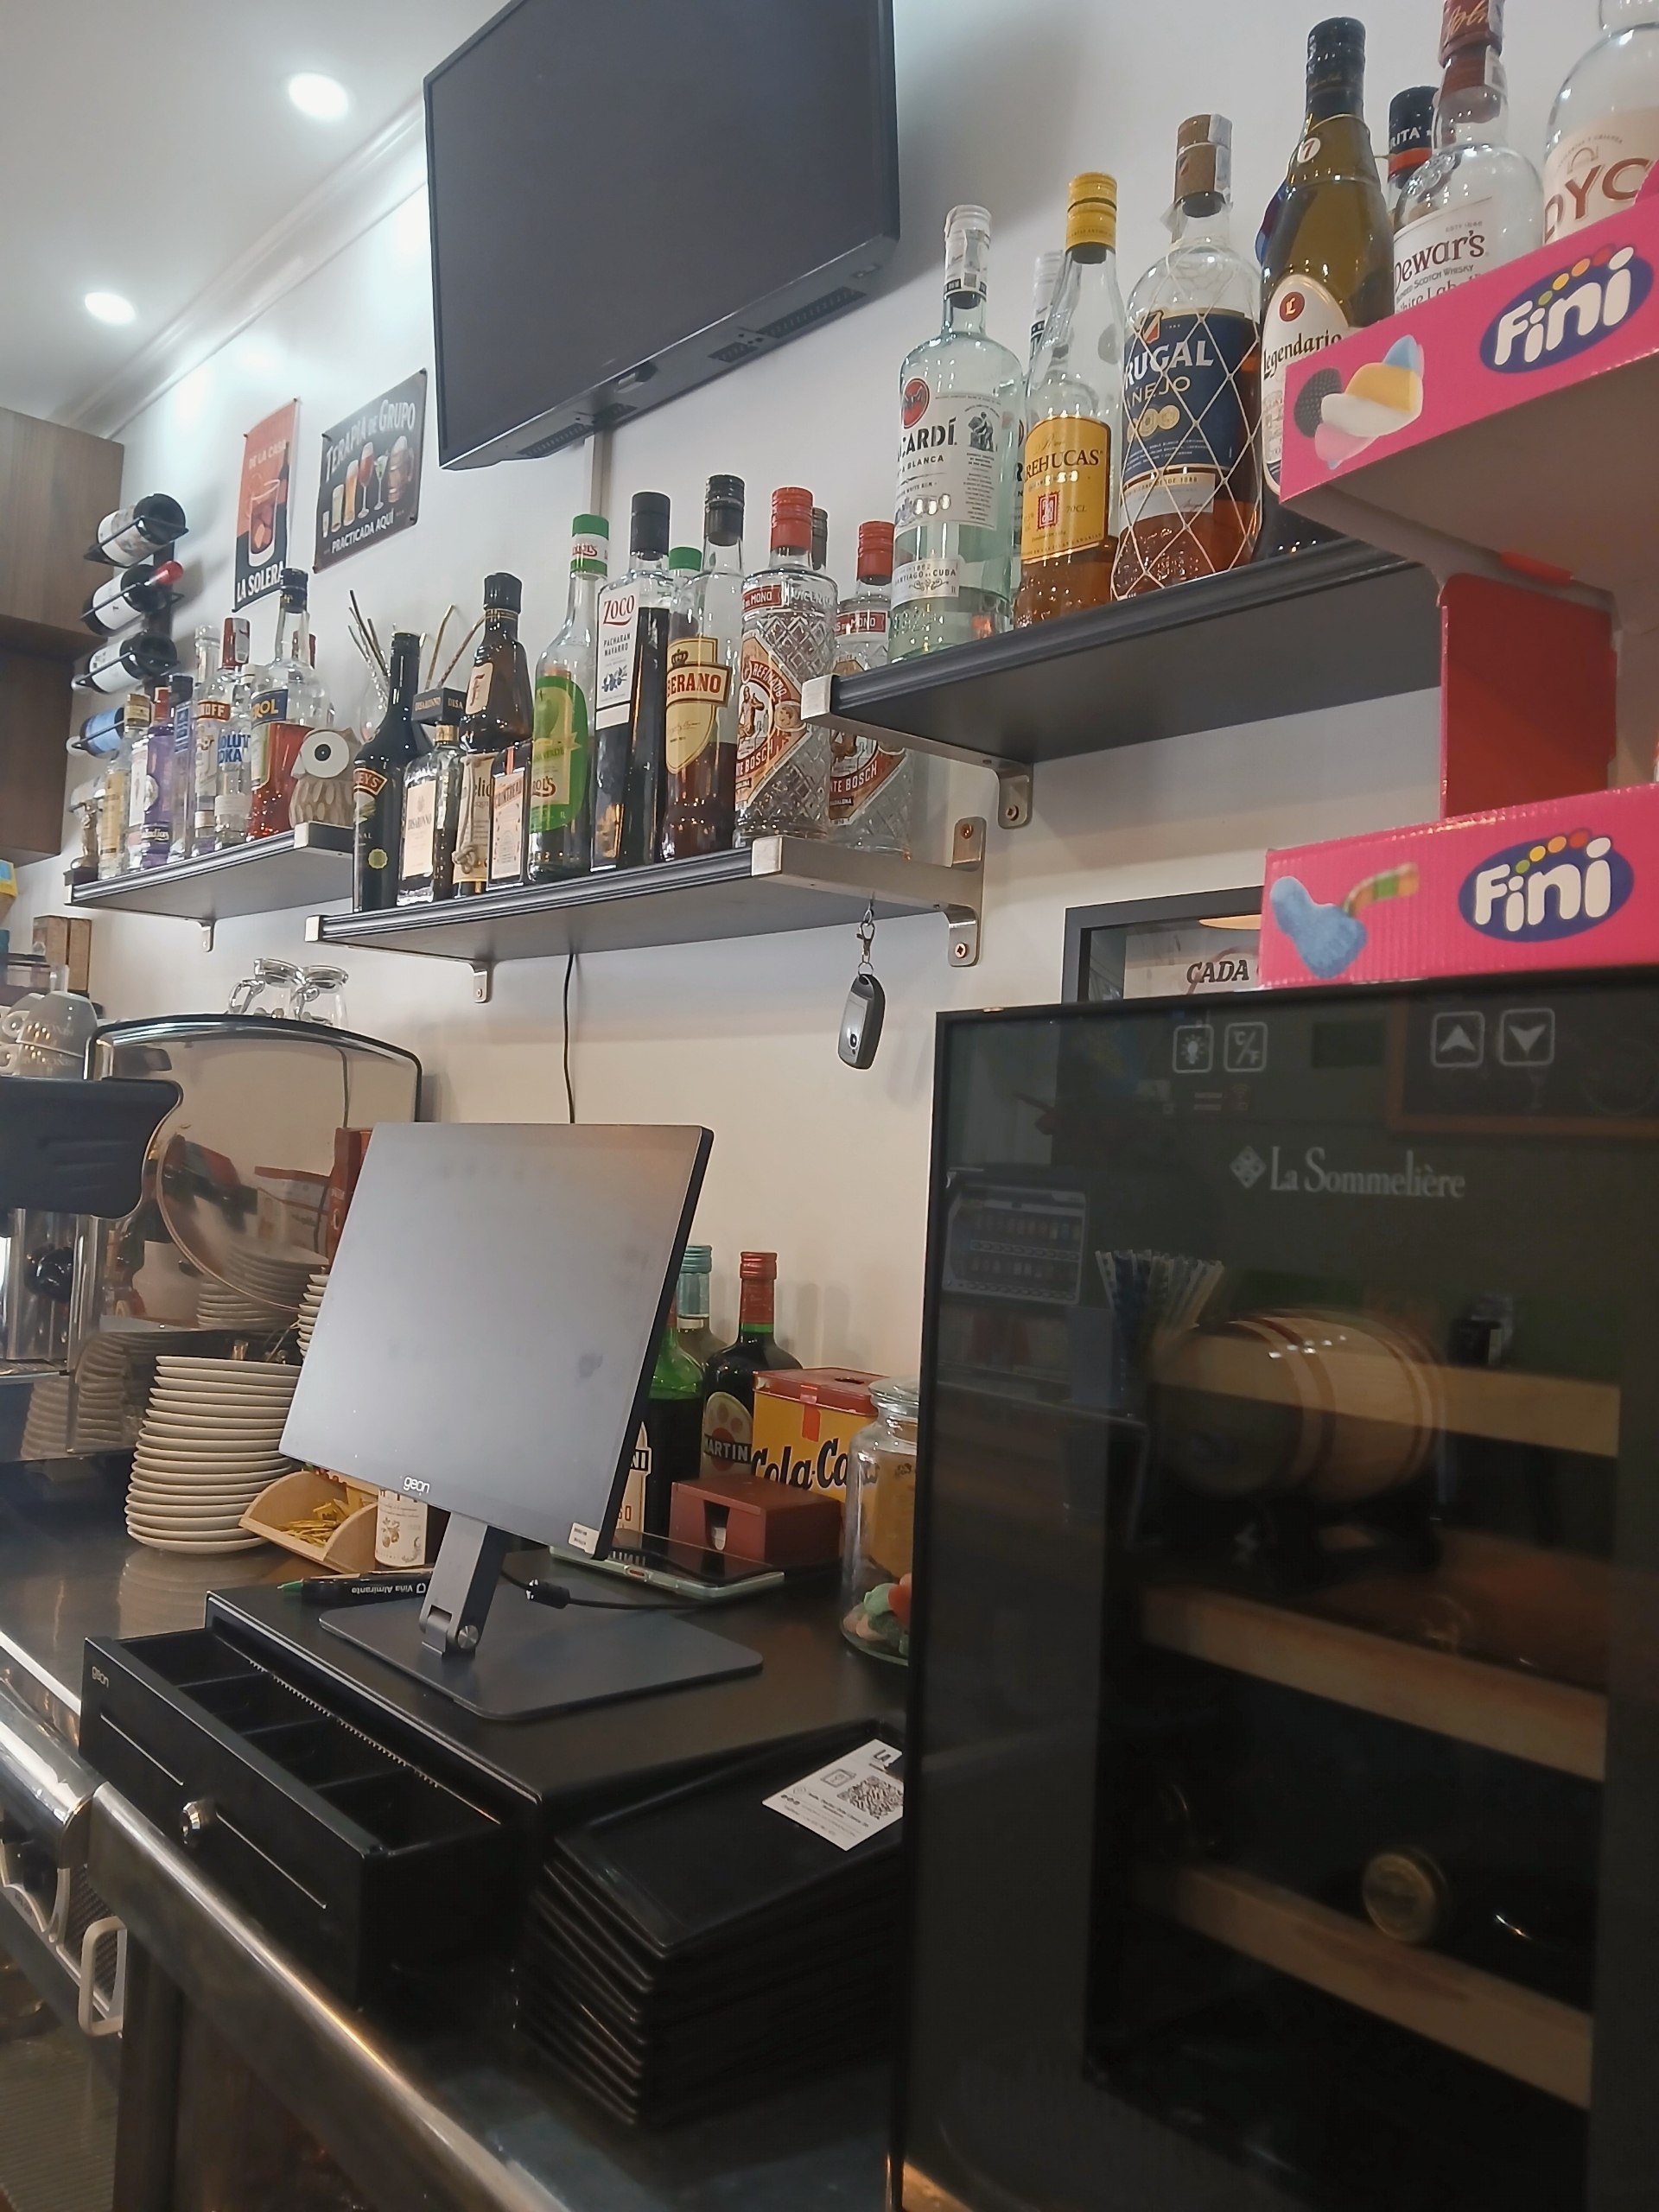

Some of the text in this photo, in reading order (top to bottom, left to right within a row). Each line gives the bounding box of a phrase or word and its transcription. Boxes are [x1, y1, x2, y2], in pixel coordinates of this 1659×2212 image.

[1494, 246, 1634, 366] Fini
[1263, 329, 1342, 380] Legendario
[324, 423, 367, 483] TERAPIA
[378, 398, 416, 432] GRUPO
[907, 454, 944, 470] BLANCA
[331, 522, 375, 555] PRACTICADA
[236, 559, 284, 602] LA SOLERA
[602, 594, 635, 626] ZOCO
[753, 662, 787, 698] REFINADO
[845, 760, 877, 791] BOSCH
[1473, 836, 1613, 933] Fini
[1186, 960, 1250, 984] CADA
[1269, 1146, 1466, 1199] La Sommelière
[351, 1585, 394, 1595] Almirante
